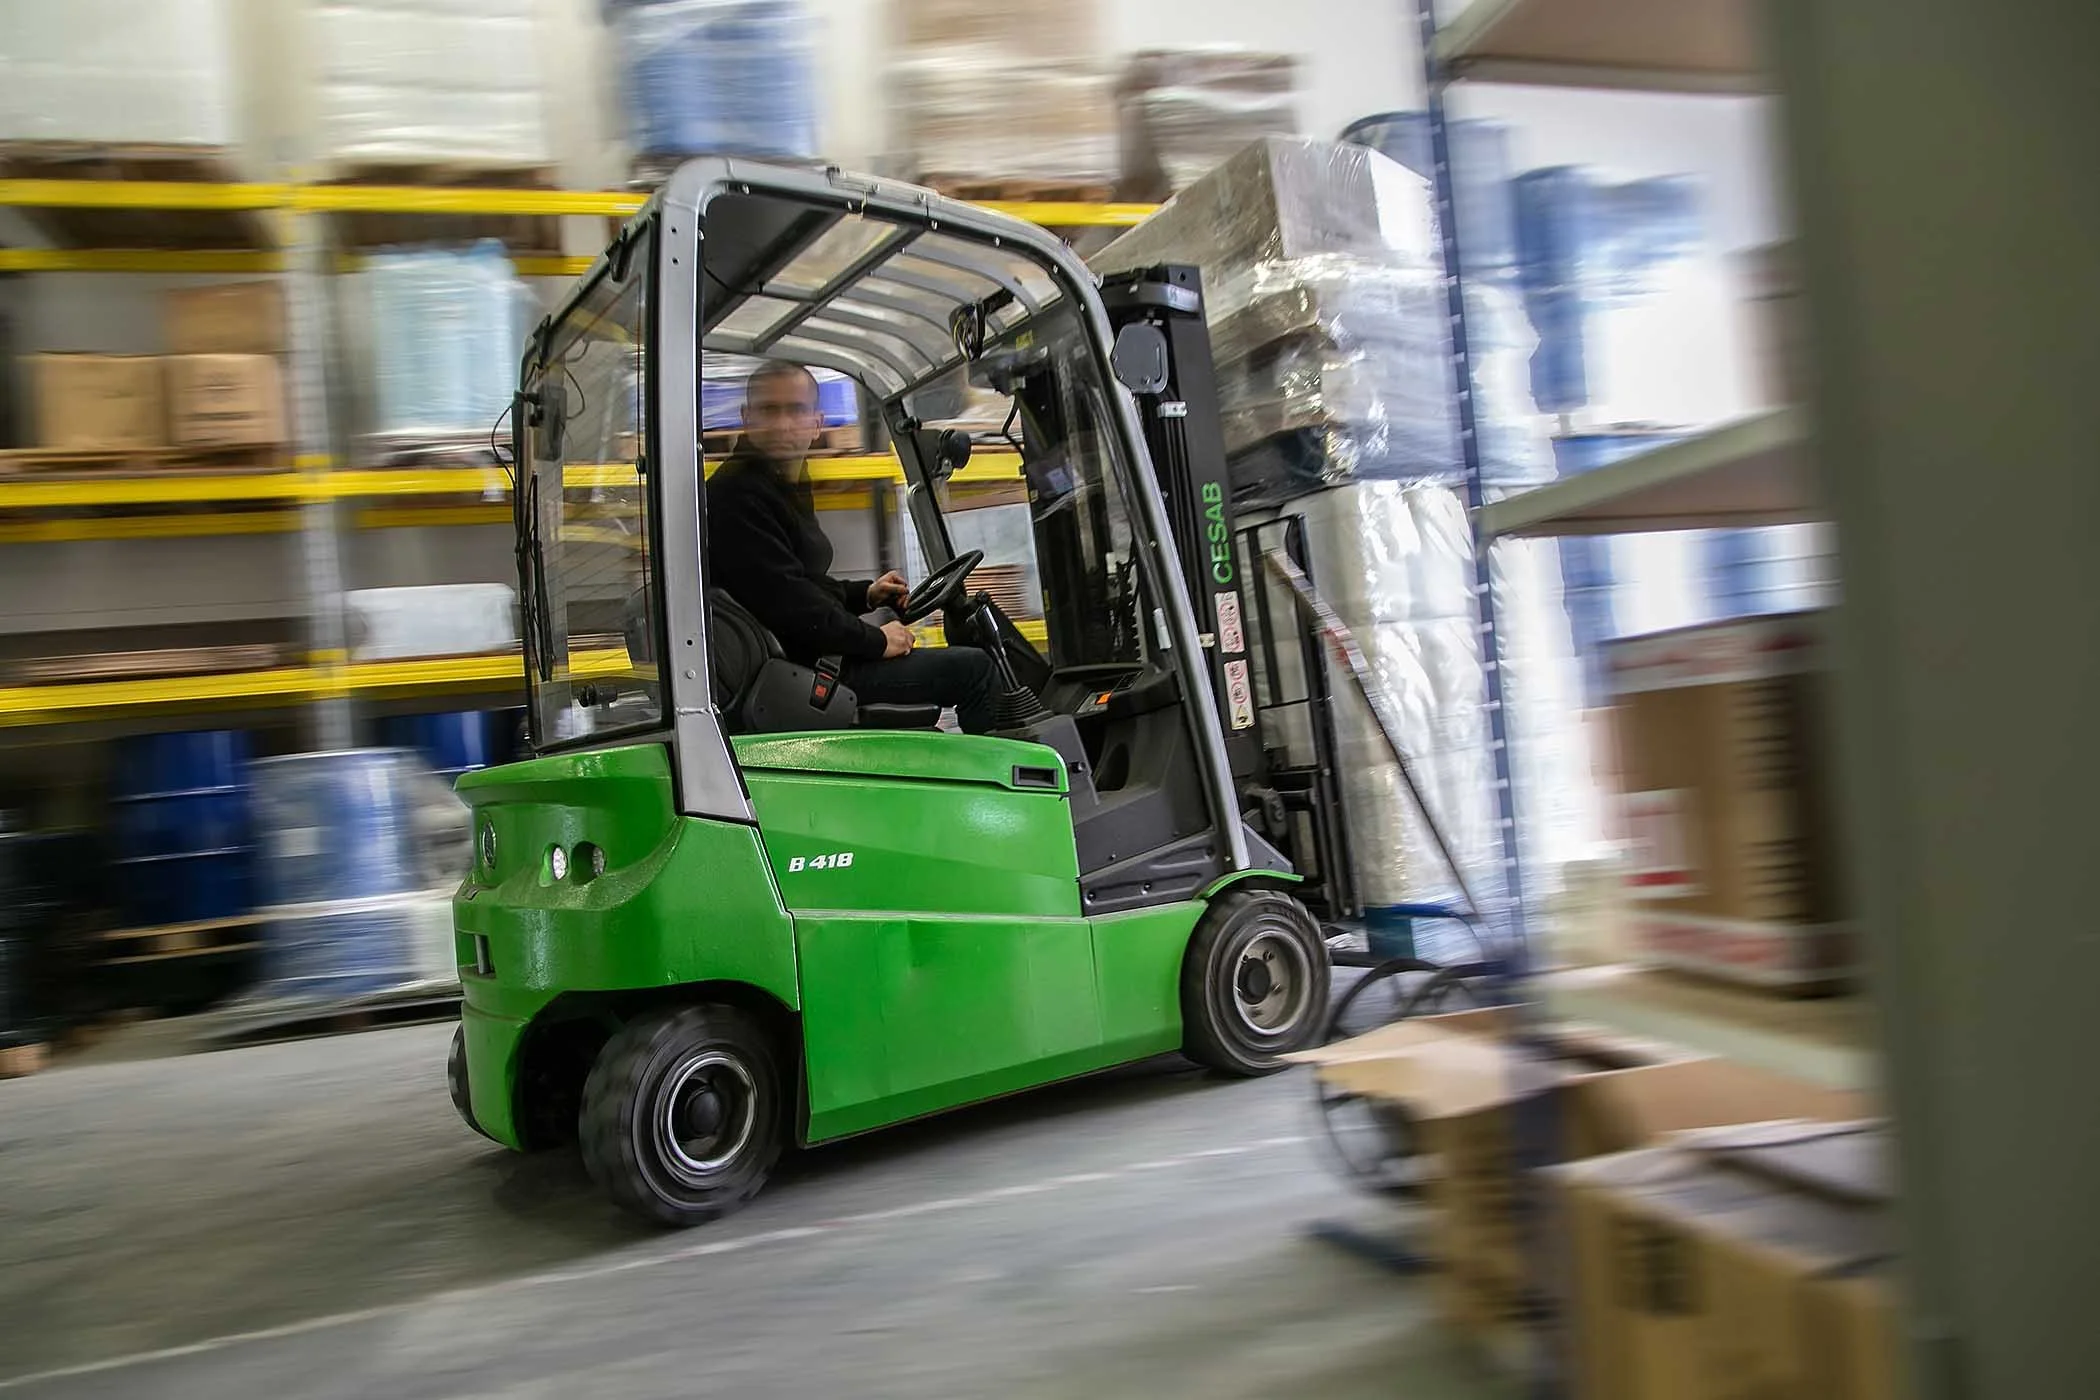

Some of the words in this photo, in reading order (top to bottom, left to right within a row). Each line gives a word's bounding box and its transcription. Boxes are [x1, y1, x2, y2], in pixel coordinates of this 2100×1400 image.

[1202, 482, 1233, 584] CESAB
[789, 857, 805, 872] B
[809, 853, 854, 869] 418
